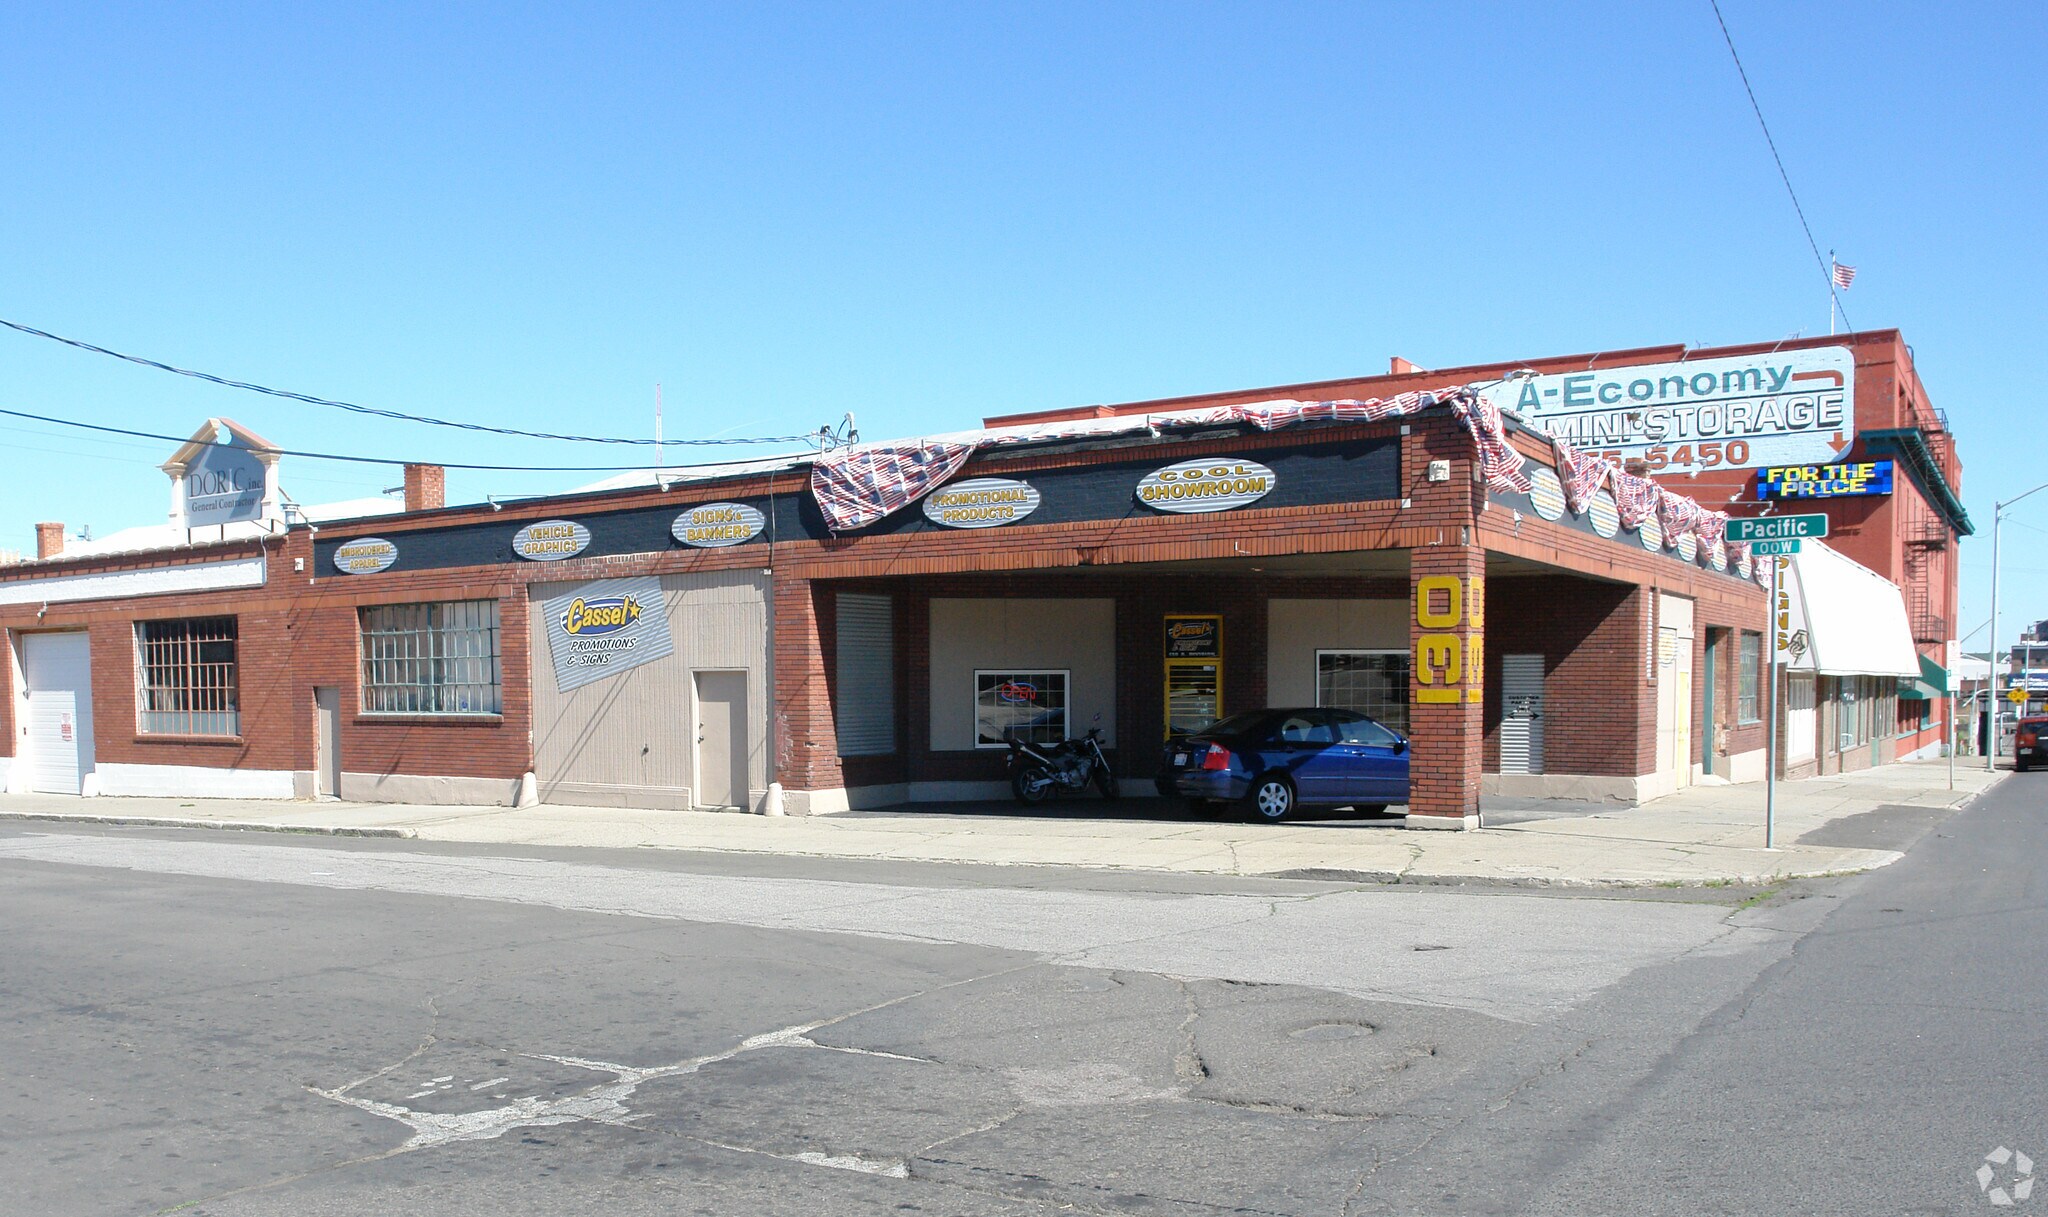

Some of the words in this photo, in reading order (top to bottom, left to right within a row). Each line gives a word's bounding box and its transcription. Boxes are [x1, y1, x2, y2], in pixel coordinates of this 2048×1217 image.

[1516, 364, 1793, 411] A-Economy
[1158, 465, 1252, 481] COOL
[1767, 466, 1819, 483] FOR
[1823, 462, 1876, 480] THE
[1141, 477, 1266, 501] SHOWROOM
[1780, 477, 1867, 497] PRICE
[191, 500, 218, 513] General
[219, 498, 255, 510] Contractor
[932, 488, 1028, 507] PROMOTIONAL
[692, 508, 733, 525] SIGNS
[943, 506, 1014, 521] PRODUCTS
[528, 525, 575, 540] VEHICLE
[686, 524, 751, 541] BANNERS
[1741, 518, 1808, 539] Pacific
[340, 544, 390, 558] EMBROIDERED
[523, 540, 578, 555] GRAPHICS
[349, 557, 381, 570] APPAREL
[567, 595, 631, 634] Cassel
[570, 637, 637, 652] PROMOTIONS
[566, 655, 577, 666] &
[580, 653, 611, 665] SIGNS
[1001, 684, 1036, 700] OPEN
